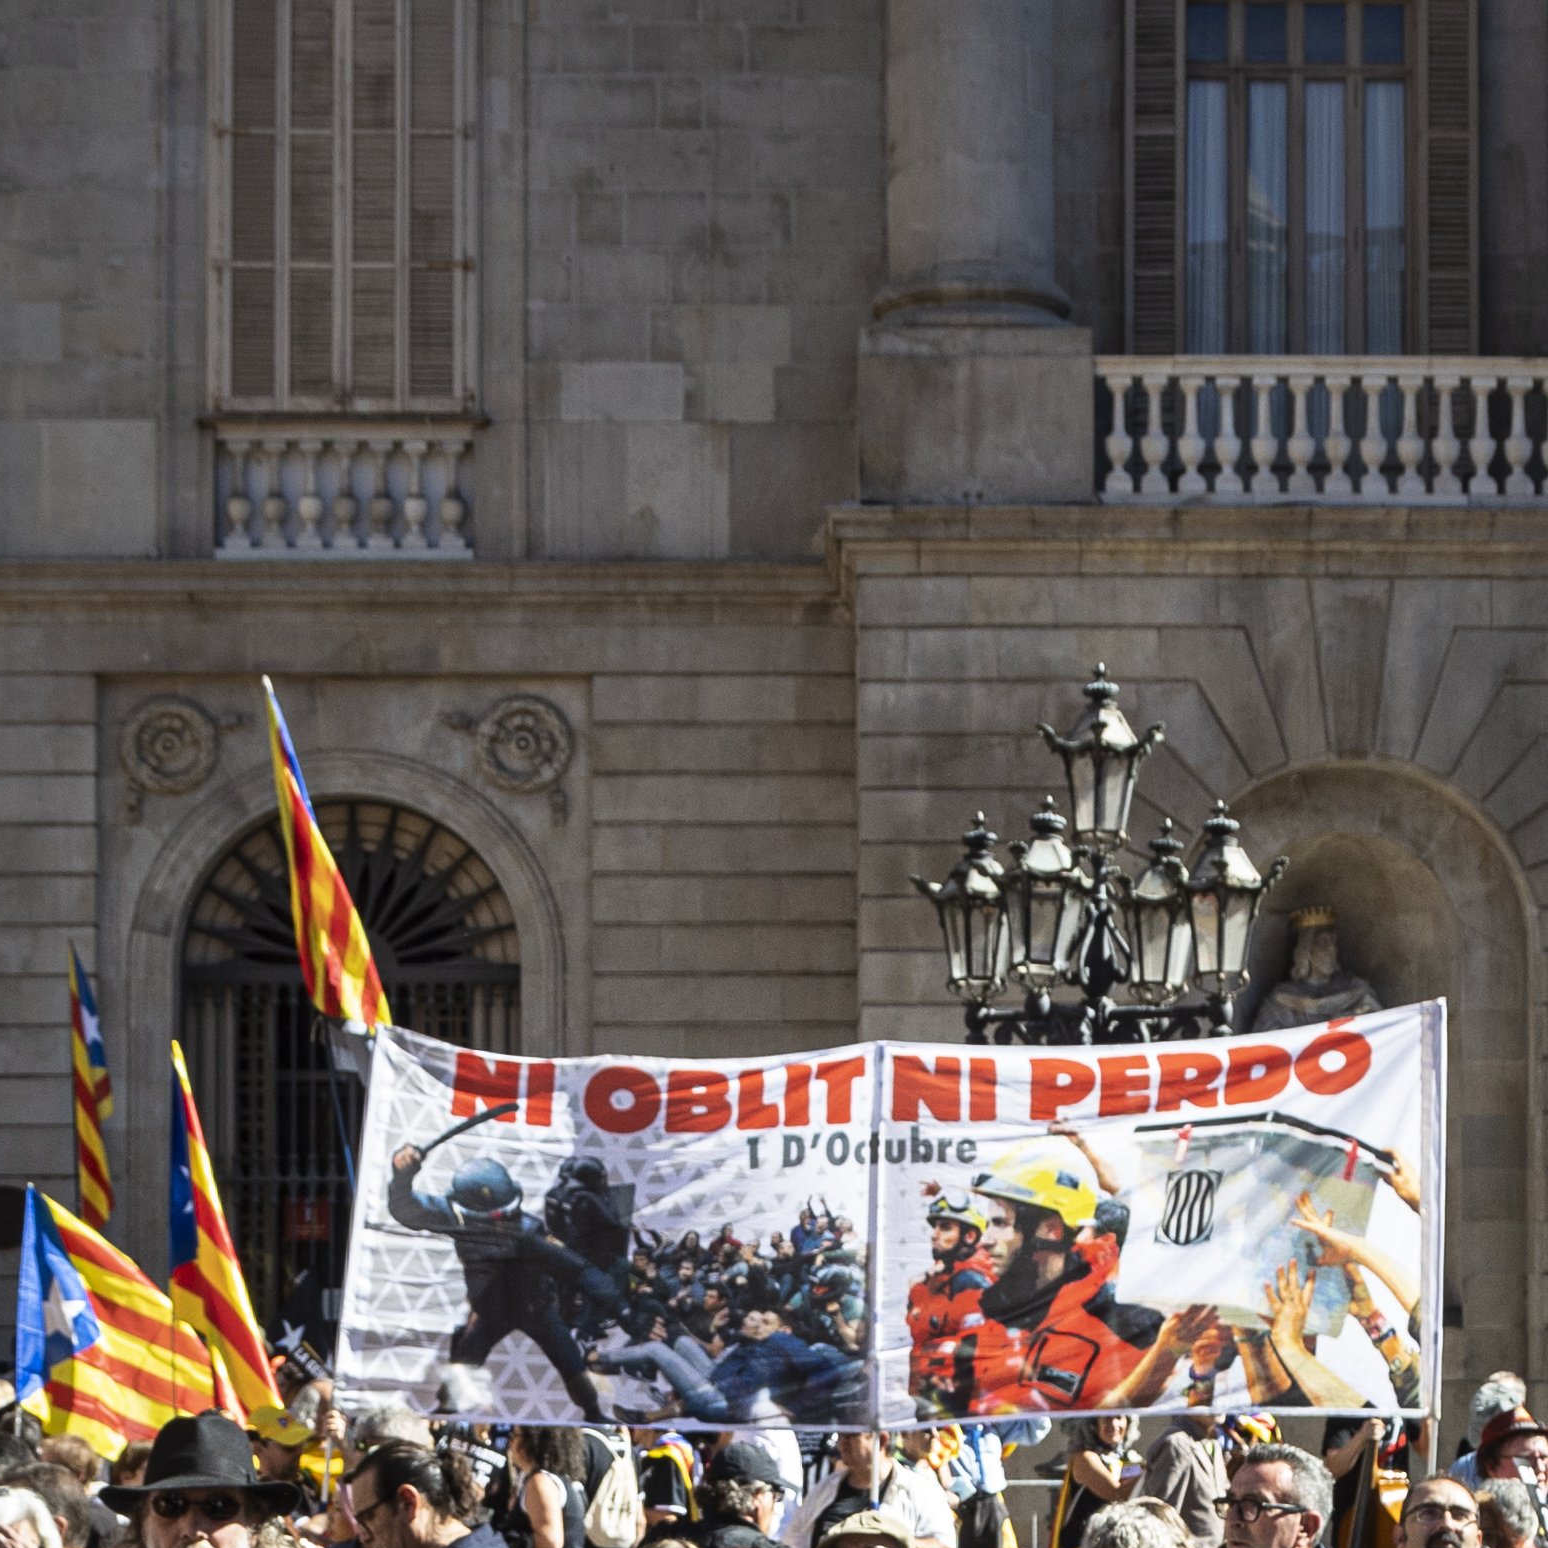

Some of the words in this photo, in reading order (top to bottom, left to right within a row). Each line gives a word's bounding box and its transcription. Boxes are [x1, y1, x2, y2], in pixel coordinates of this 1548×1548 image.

[452, 1050, 557, 1127] NI
[584, 1055, 866, 1134] OBLIT
[891, 1055, 997, 1122] NI
[1029, 1017, 1372, 1121] PERDÓ
[746, 1136, 760, 1170] 1
